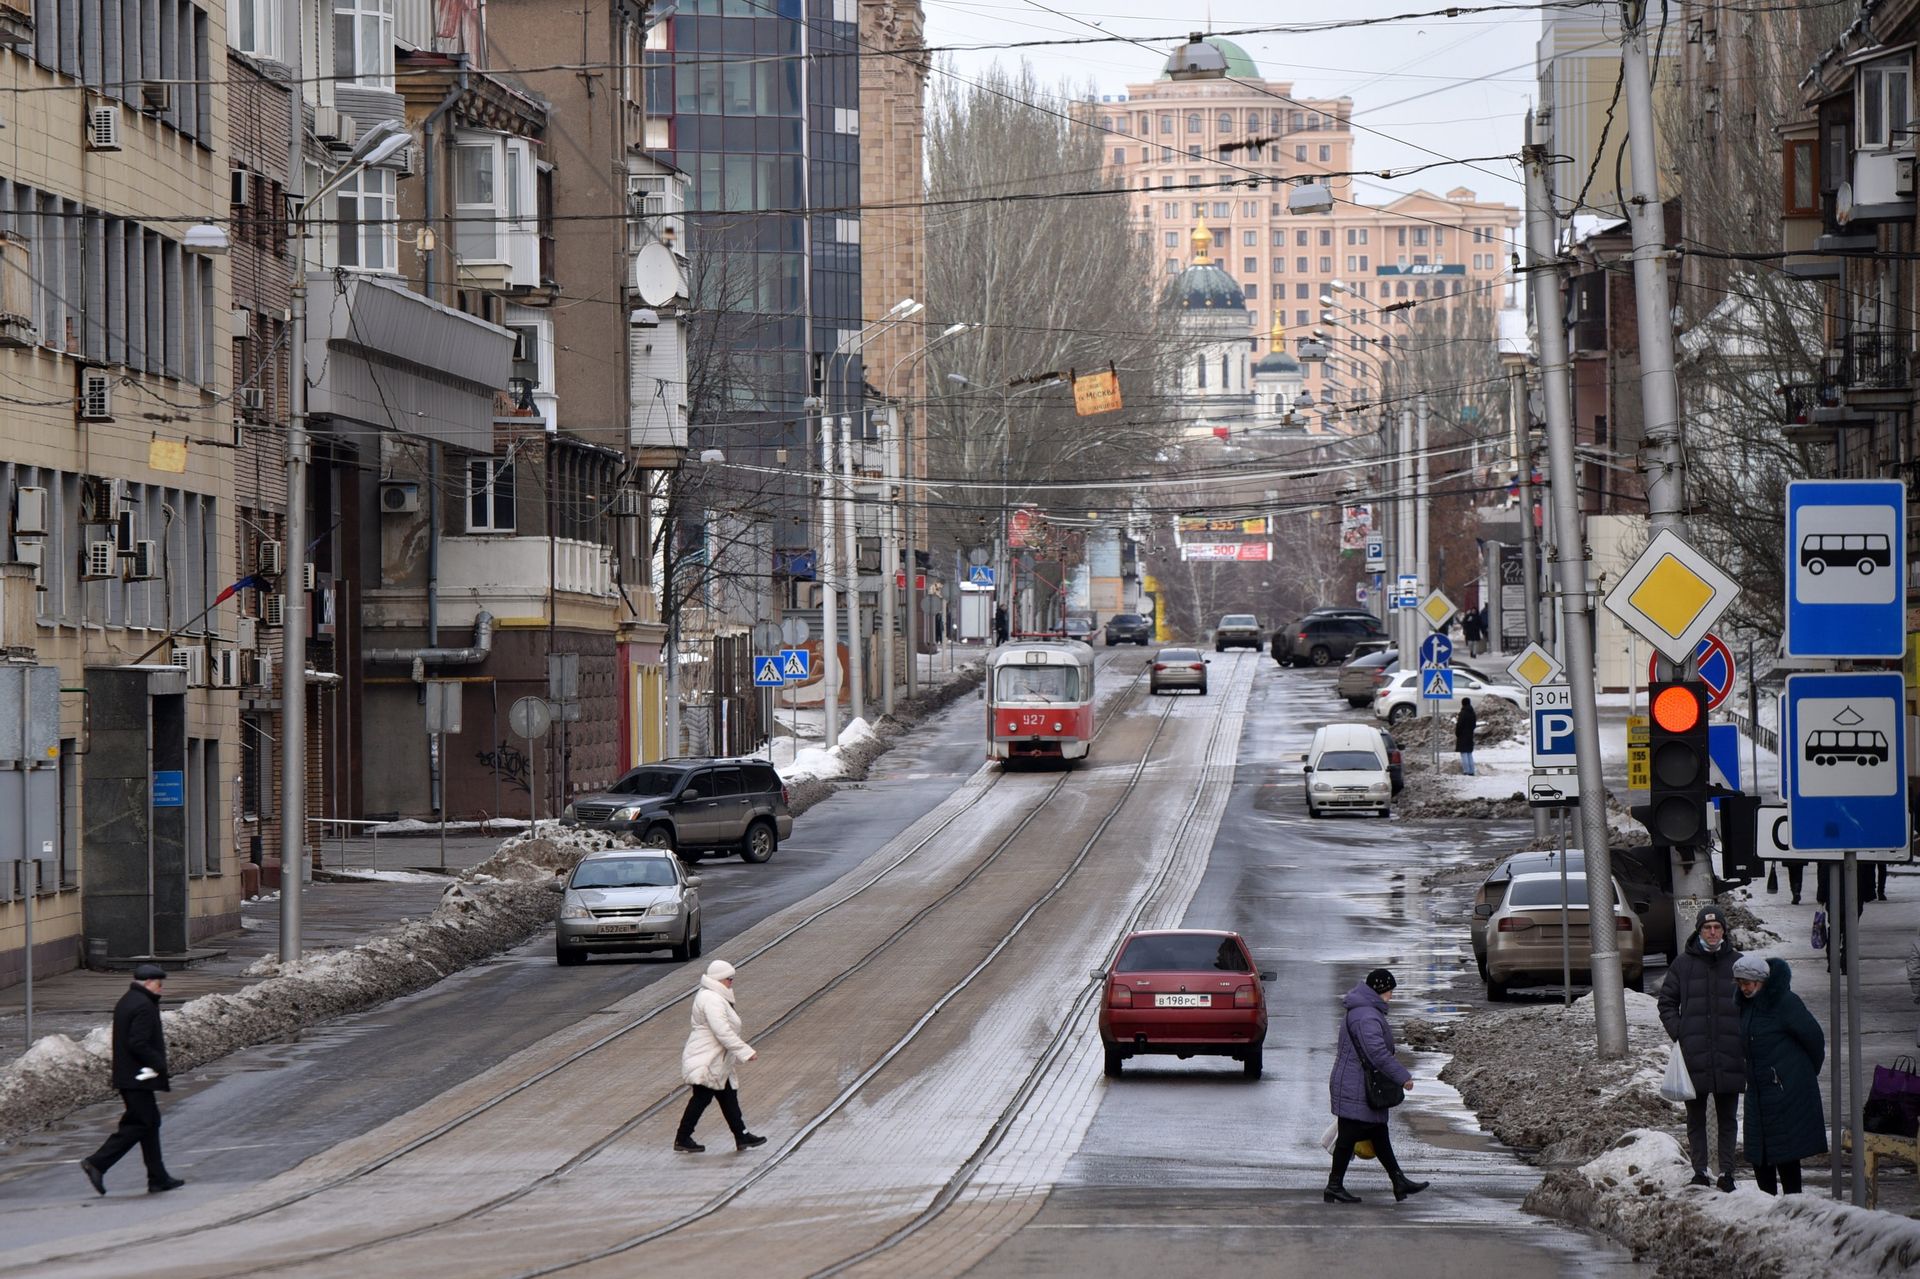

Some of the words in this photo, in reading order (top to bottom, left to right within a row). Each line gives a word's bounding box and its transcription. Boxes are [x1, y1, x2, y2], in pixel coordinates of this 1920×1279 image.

[1412, 265, 1443, 274] ВБР
[1535, 691, 1569, 705] ЗОН
[1023, 714, 1046, 725] 927
[1542, 714, 1575, 751] P
